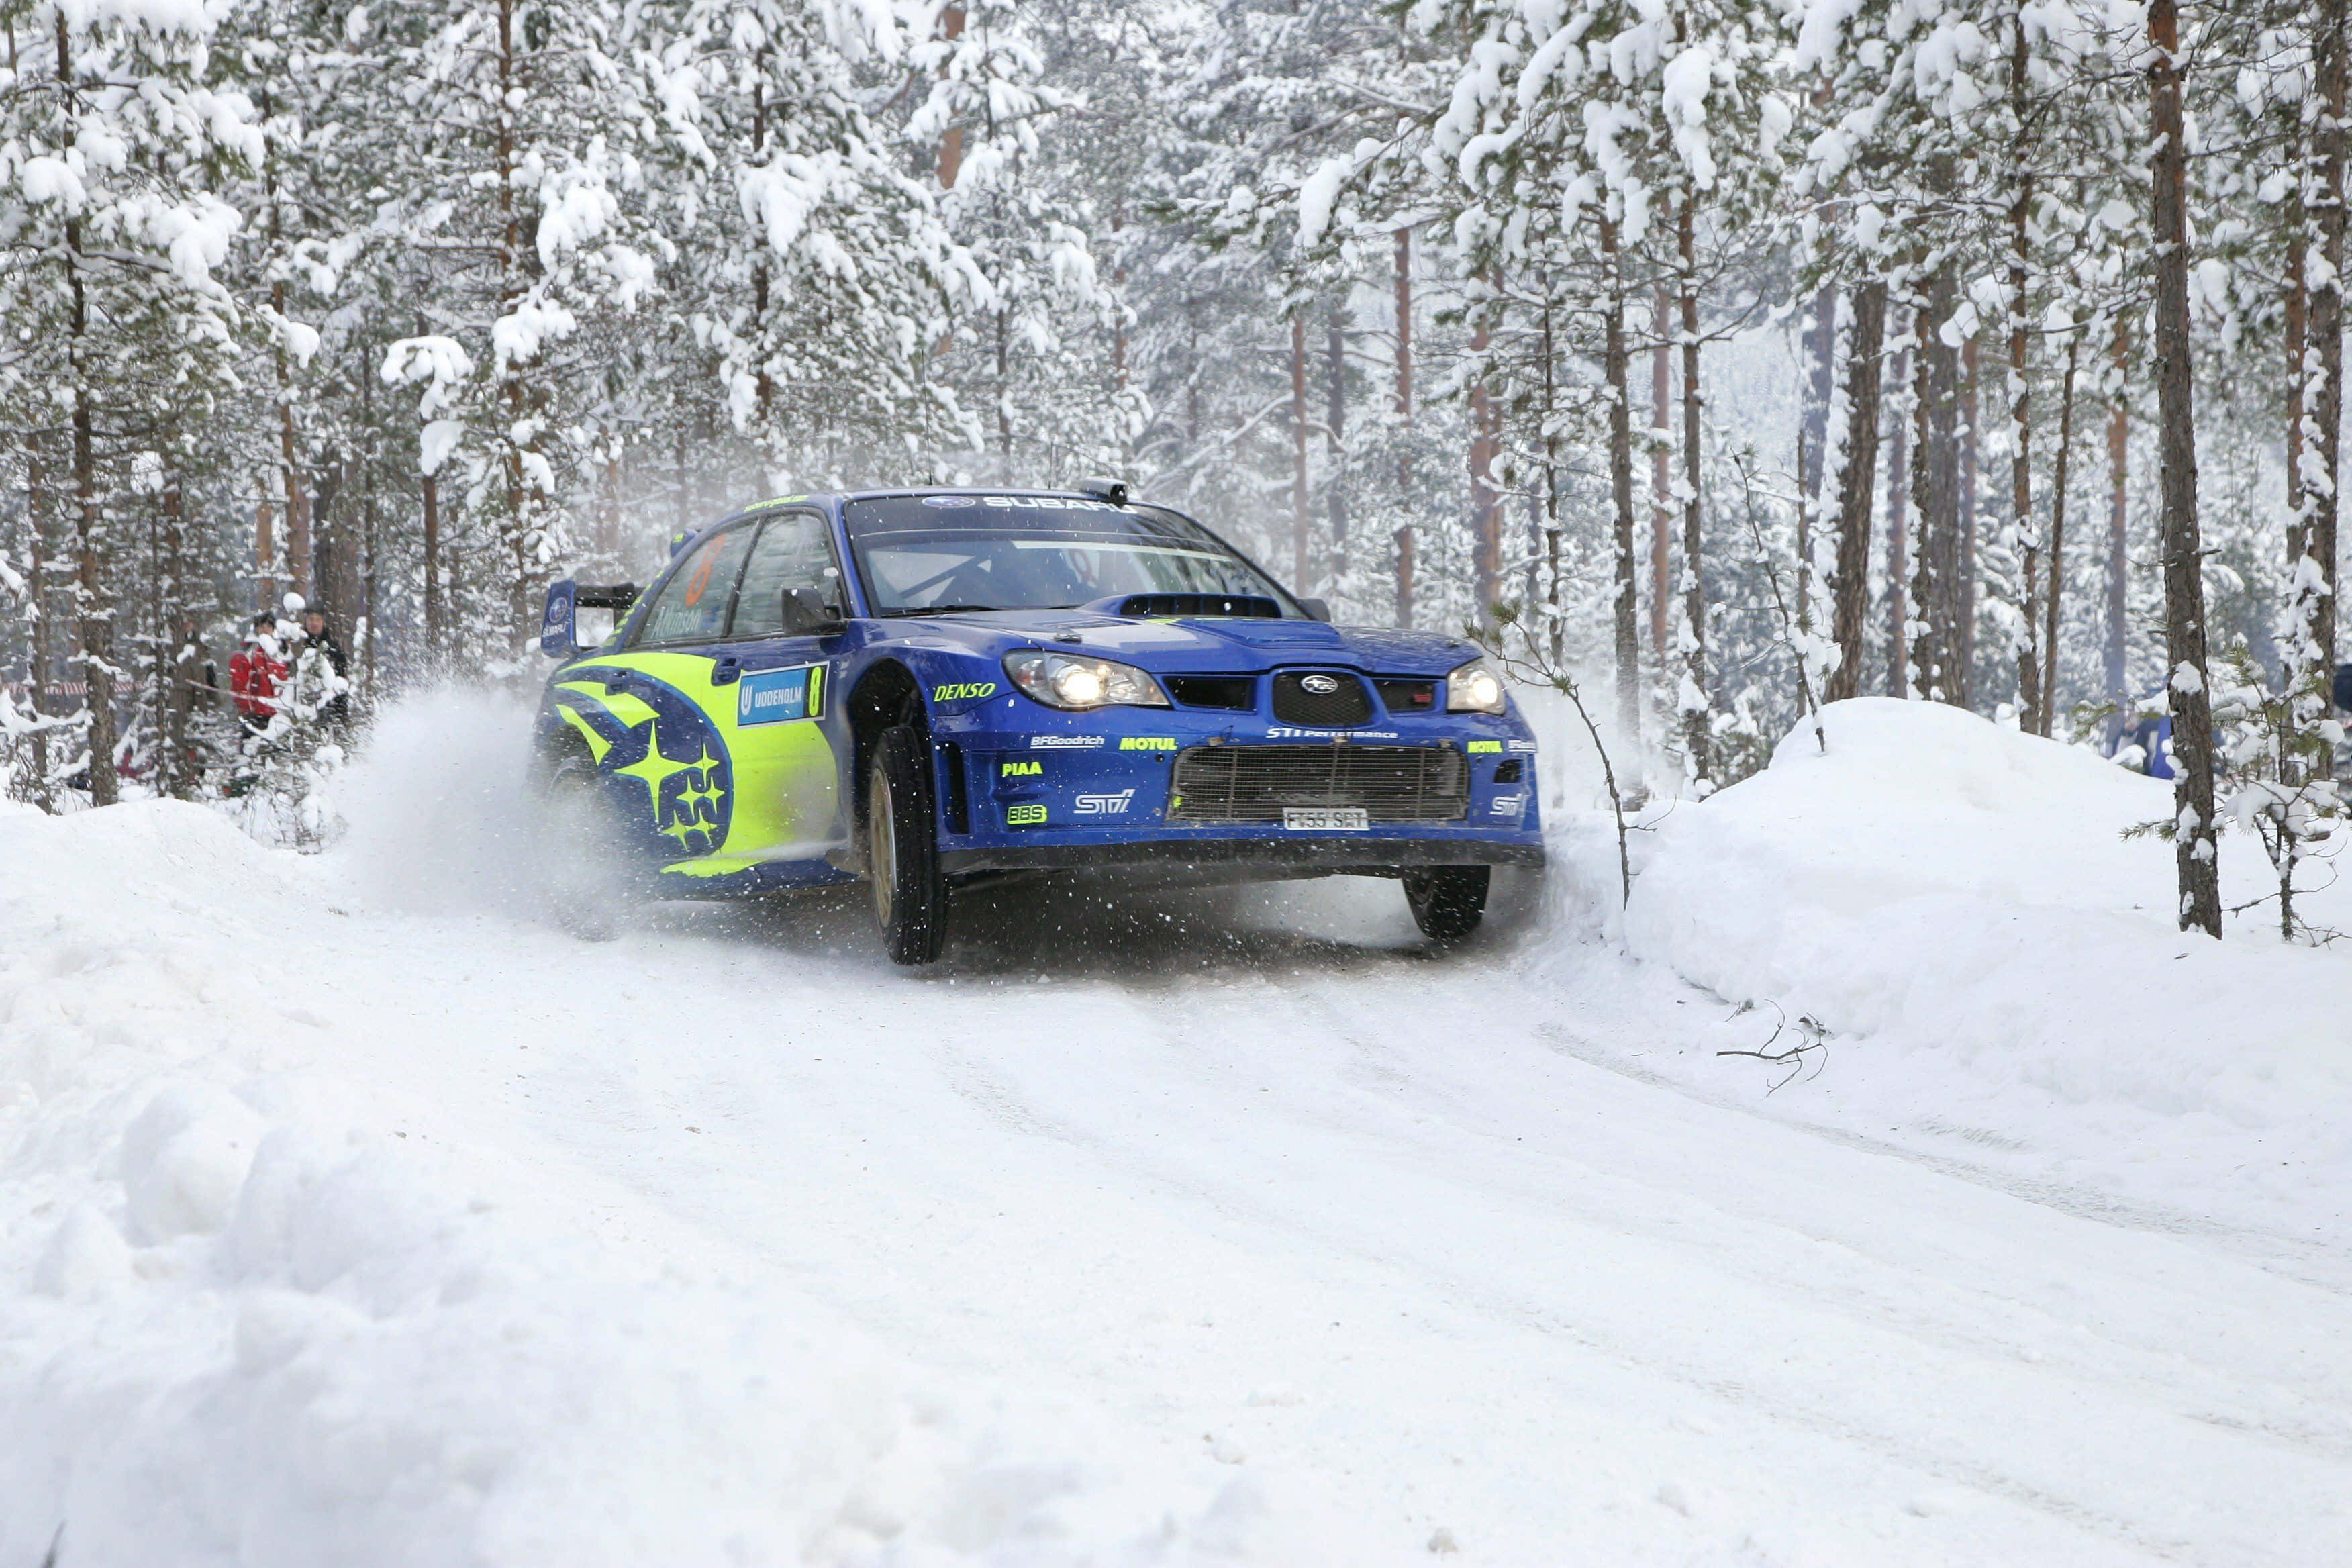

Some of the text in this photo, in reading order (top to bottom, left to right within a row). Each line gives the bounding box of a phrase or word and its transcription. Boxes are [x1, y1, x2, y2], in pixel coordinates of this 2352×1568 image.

[983, 497, 1138, 514] SUBARU
[755, 686, 802, 708] UDDEHOLM
[808, 666, 822, 716] 8
[934, 683, 997, 702] DENSO
[1030, 736, 1105, 746] BFGoodrich
[1266, 728, 1301, 738] STI
[1119, 738, 1178, 750] MOTUL
[1003, 761, 1043, 776] PIAA
[1008, 805, 1047, 824] BBS
